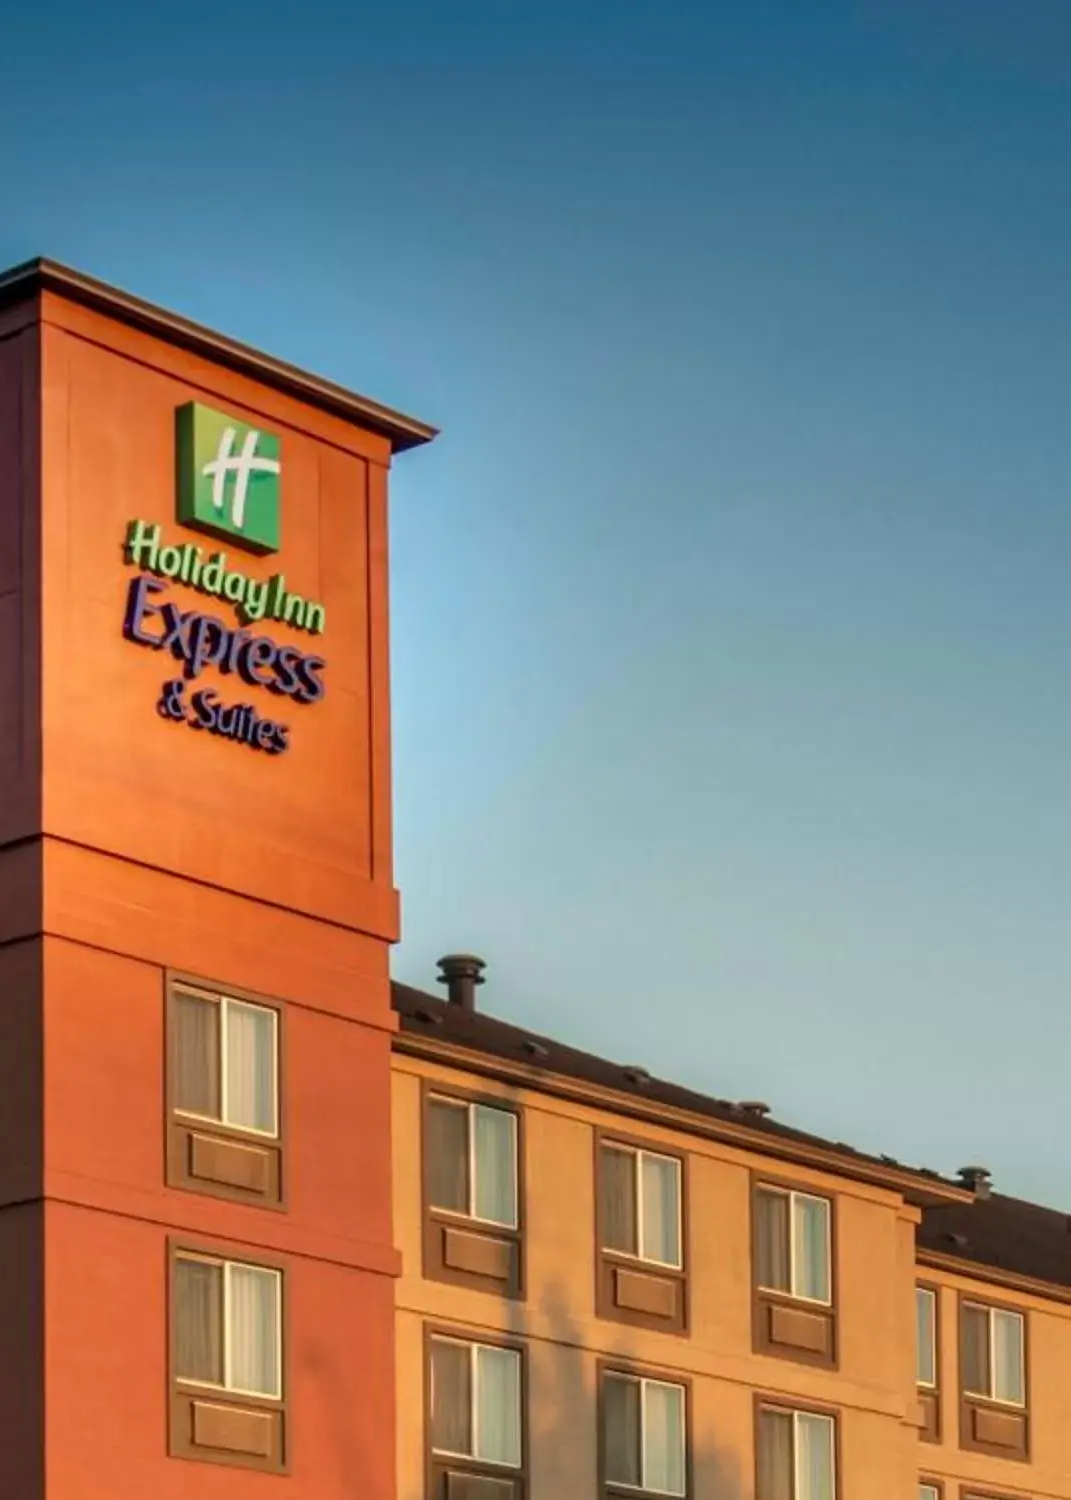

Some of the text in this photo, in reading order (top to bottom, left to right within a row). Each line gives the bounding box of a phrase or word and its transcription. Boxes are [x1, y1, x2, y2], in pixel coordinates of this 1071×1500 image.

[202, 427, 281, 528] H
[126, 520, 326, 633] Holiday Inn
[124, 574, 326, 703] Express
[158, 678, 289, 754] & Suites
